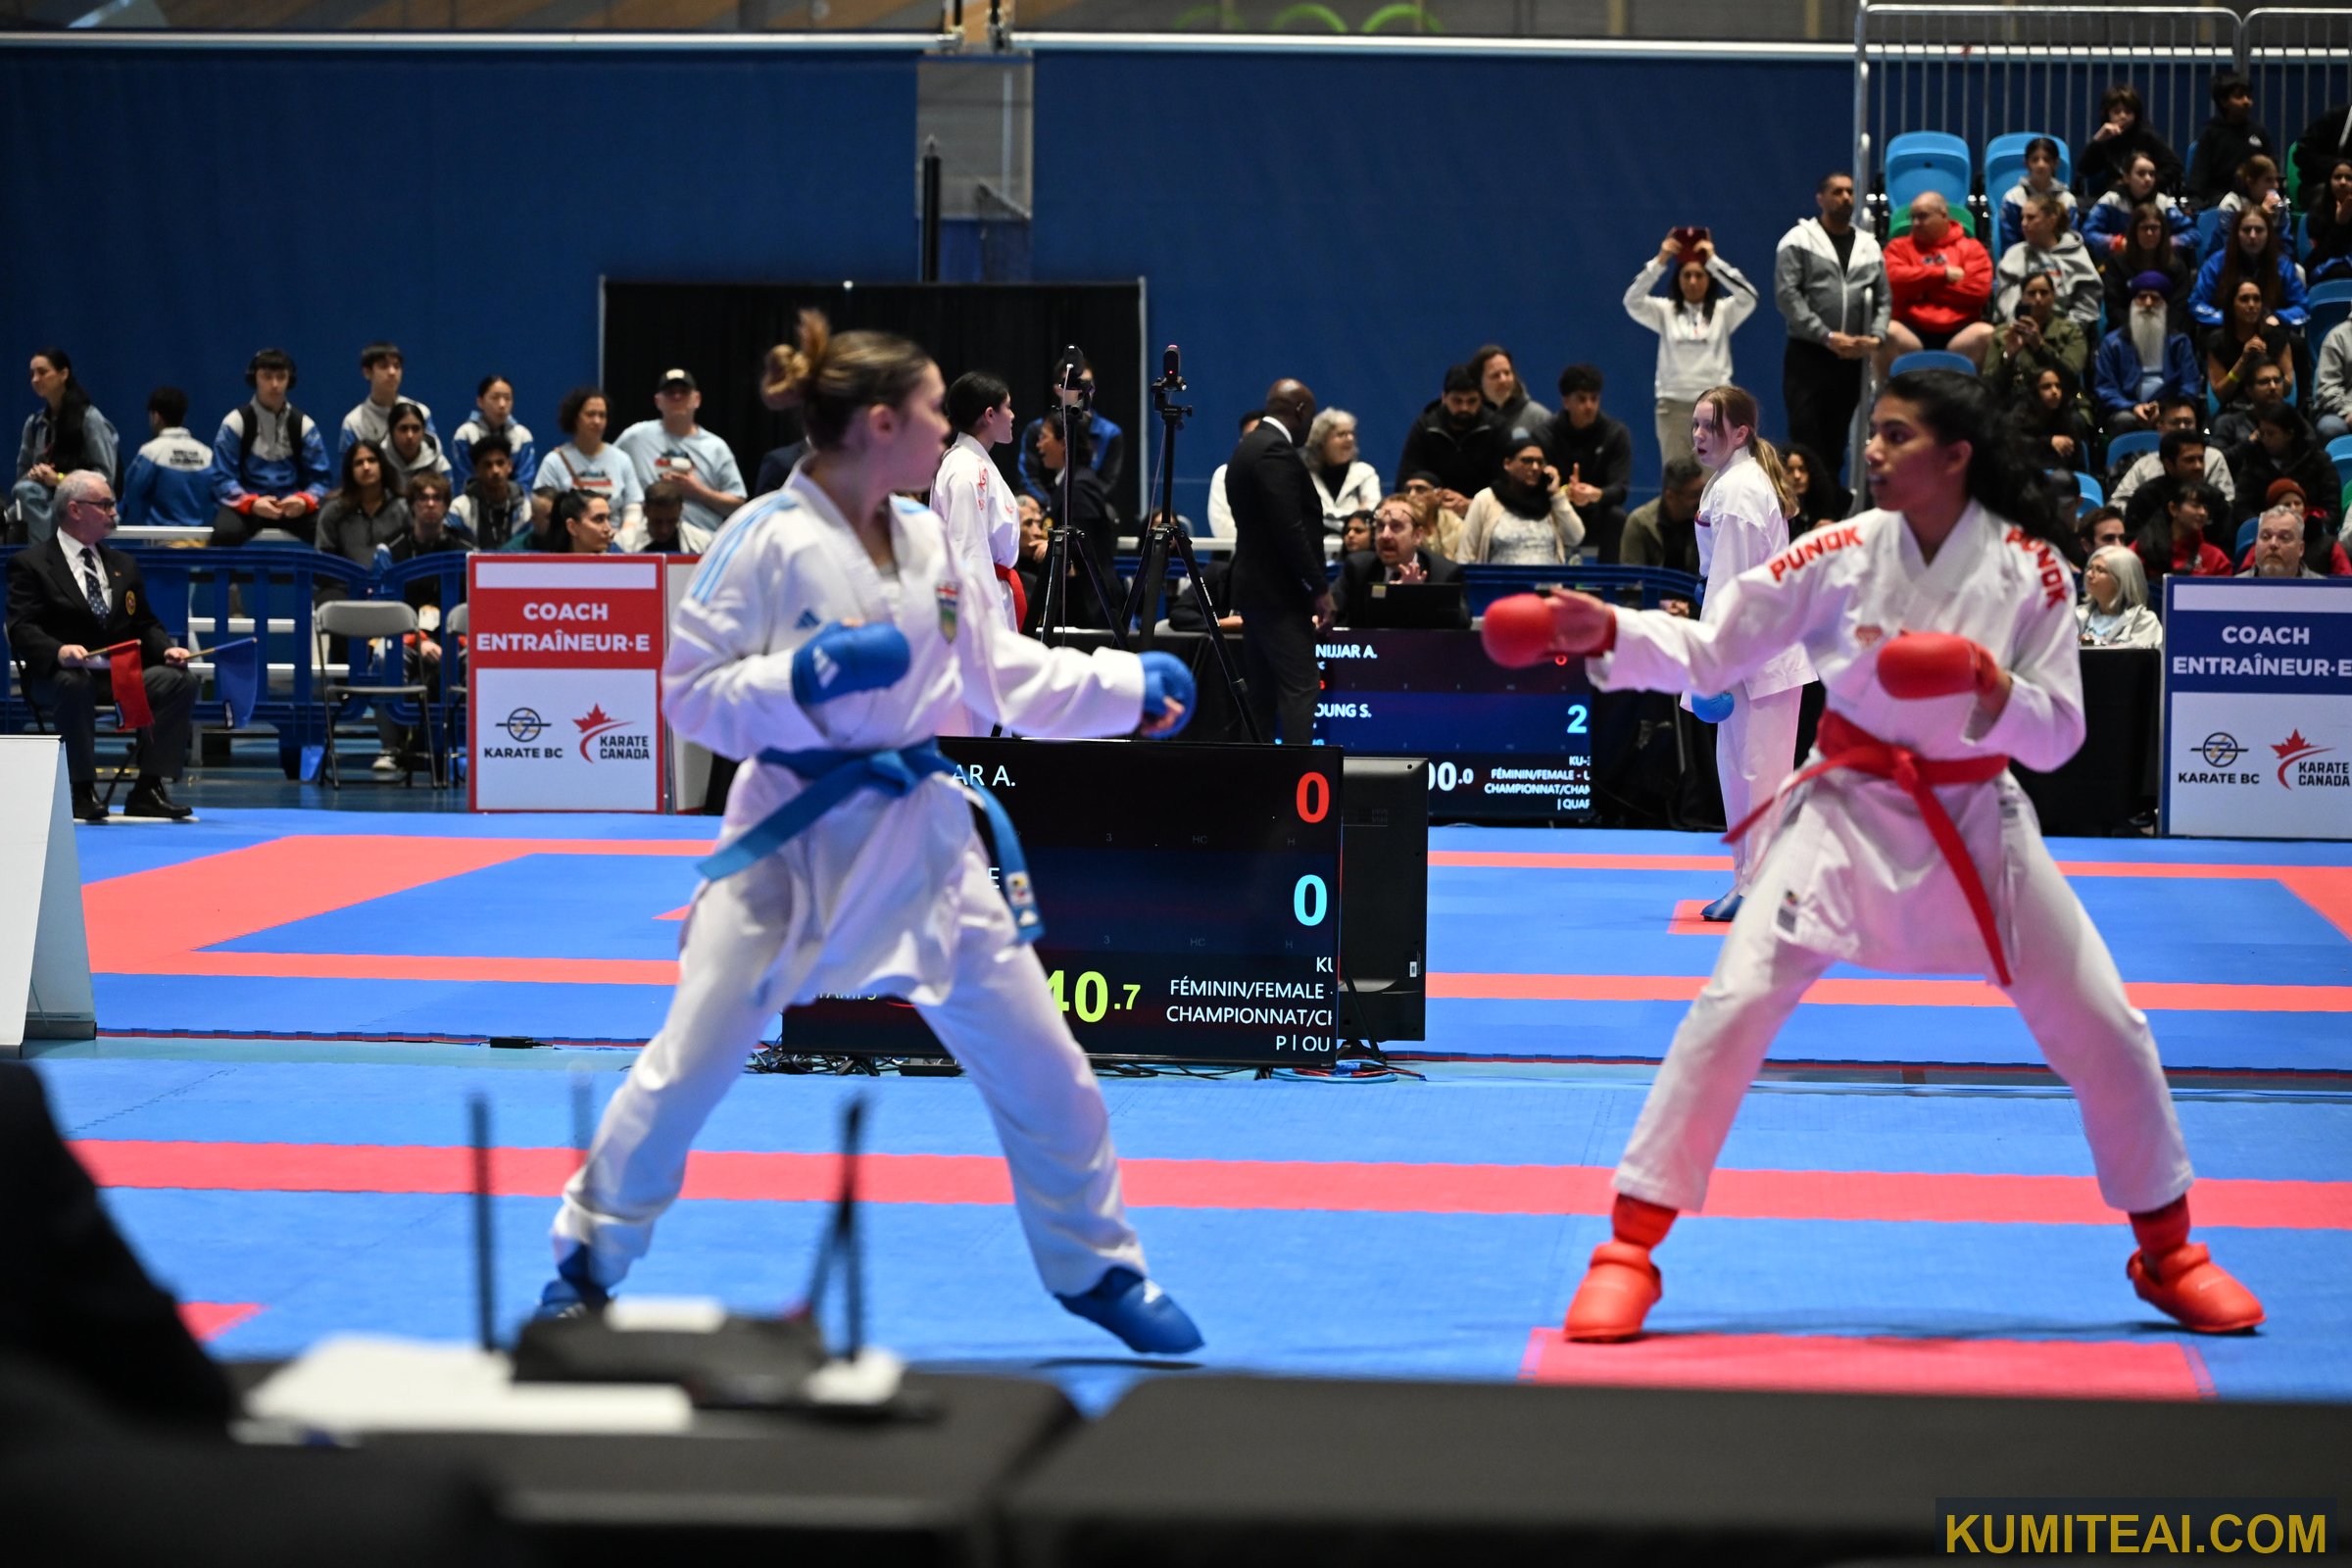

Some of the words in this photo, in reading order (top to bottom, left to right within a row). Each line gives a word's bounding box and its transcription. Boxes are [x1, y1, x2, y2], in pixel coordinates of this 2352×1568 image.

[1768, 525, 1864, 582] PUNOK
[522, 602, 609, 621] COACH
[476, 628, 651, 653] ENTRAÎNEUR·E
[2222, 625, 2311, 646] COACH
[1362, 644, 1378, 660] A.
[2172, 652, 2352, 677] ENTRAÎNEUR·E
[1358, 703, 1372, 718] S.
[1566, 704, 1588, 734] 2
[600, 735, 649, 747] KARATE
[483, 747, 541, 759] KARATE
[544, 747, 564, 759] BC
[600, 748, 650, 760] CANADA
[992, 764, 1016, 787] A.
[2298, 761, 2350, 774] KARATE
[2178, 771, 2236, 784] KARATE
[2240, 772, 2260, 785] BC
[2298, 774, 2351, 787] CANADA
[1296, 771, 1330, 823] 0
[1192, 835, 1208, 845] HC
[1287, 838, 1296, 847] H
[1294, 874, 1328, 926] 0
[1190, 938, 1206, 948] HC
[1285, 940, 1294, 950] H
[1170, 975, 1324, 1000] FÉMININ/FEMALE
[1275, 1035, 1287, 1052] P
